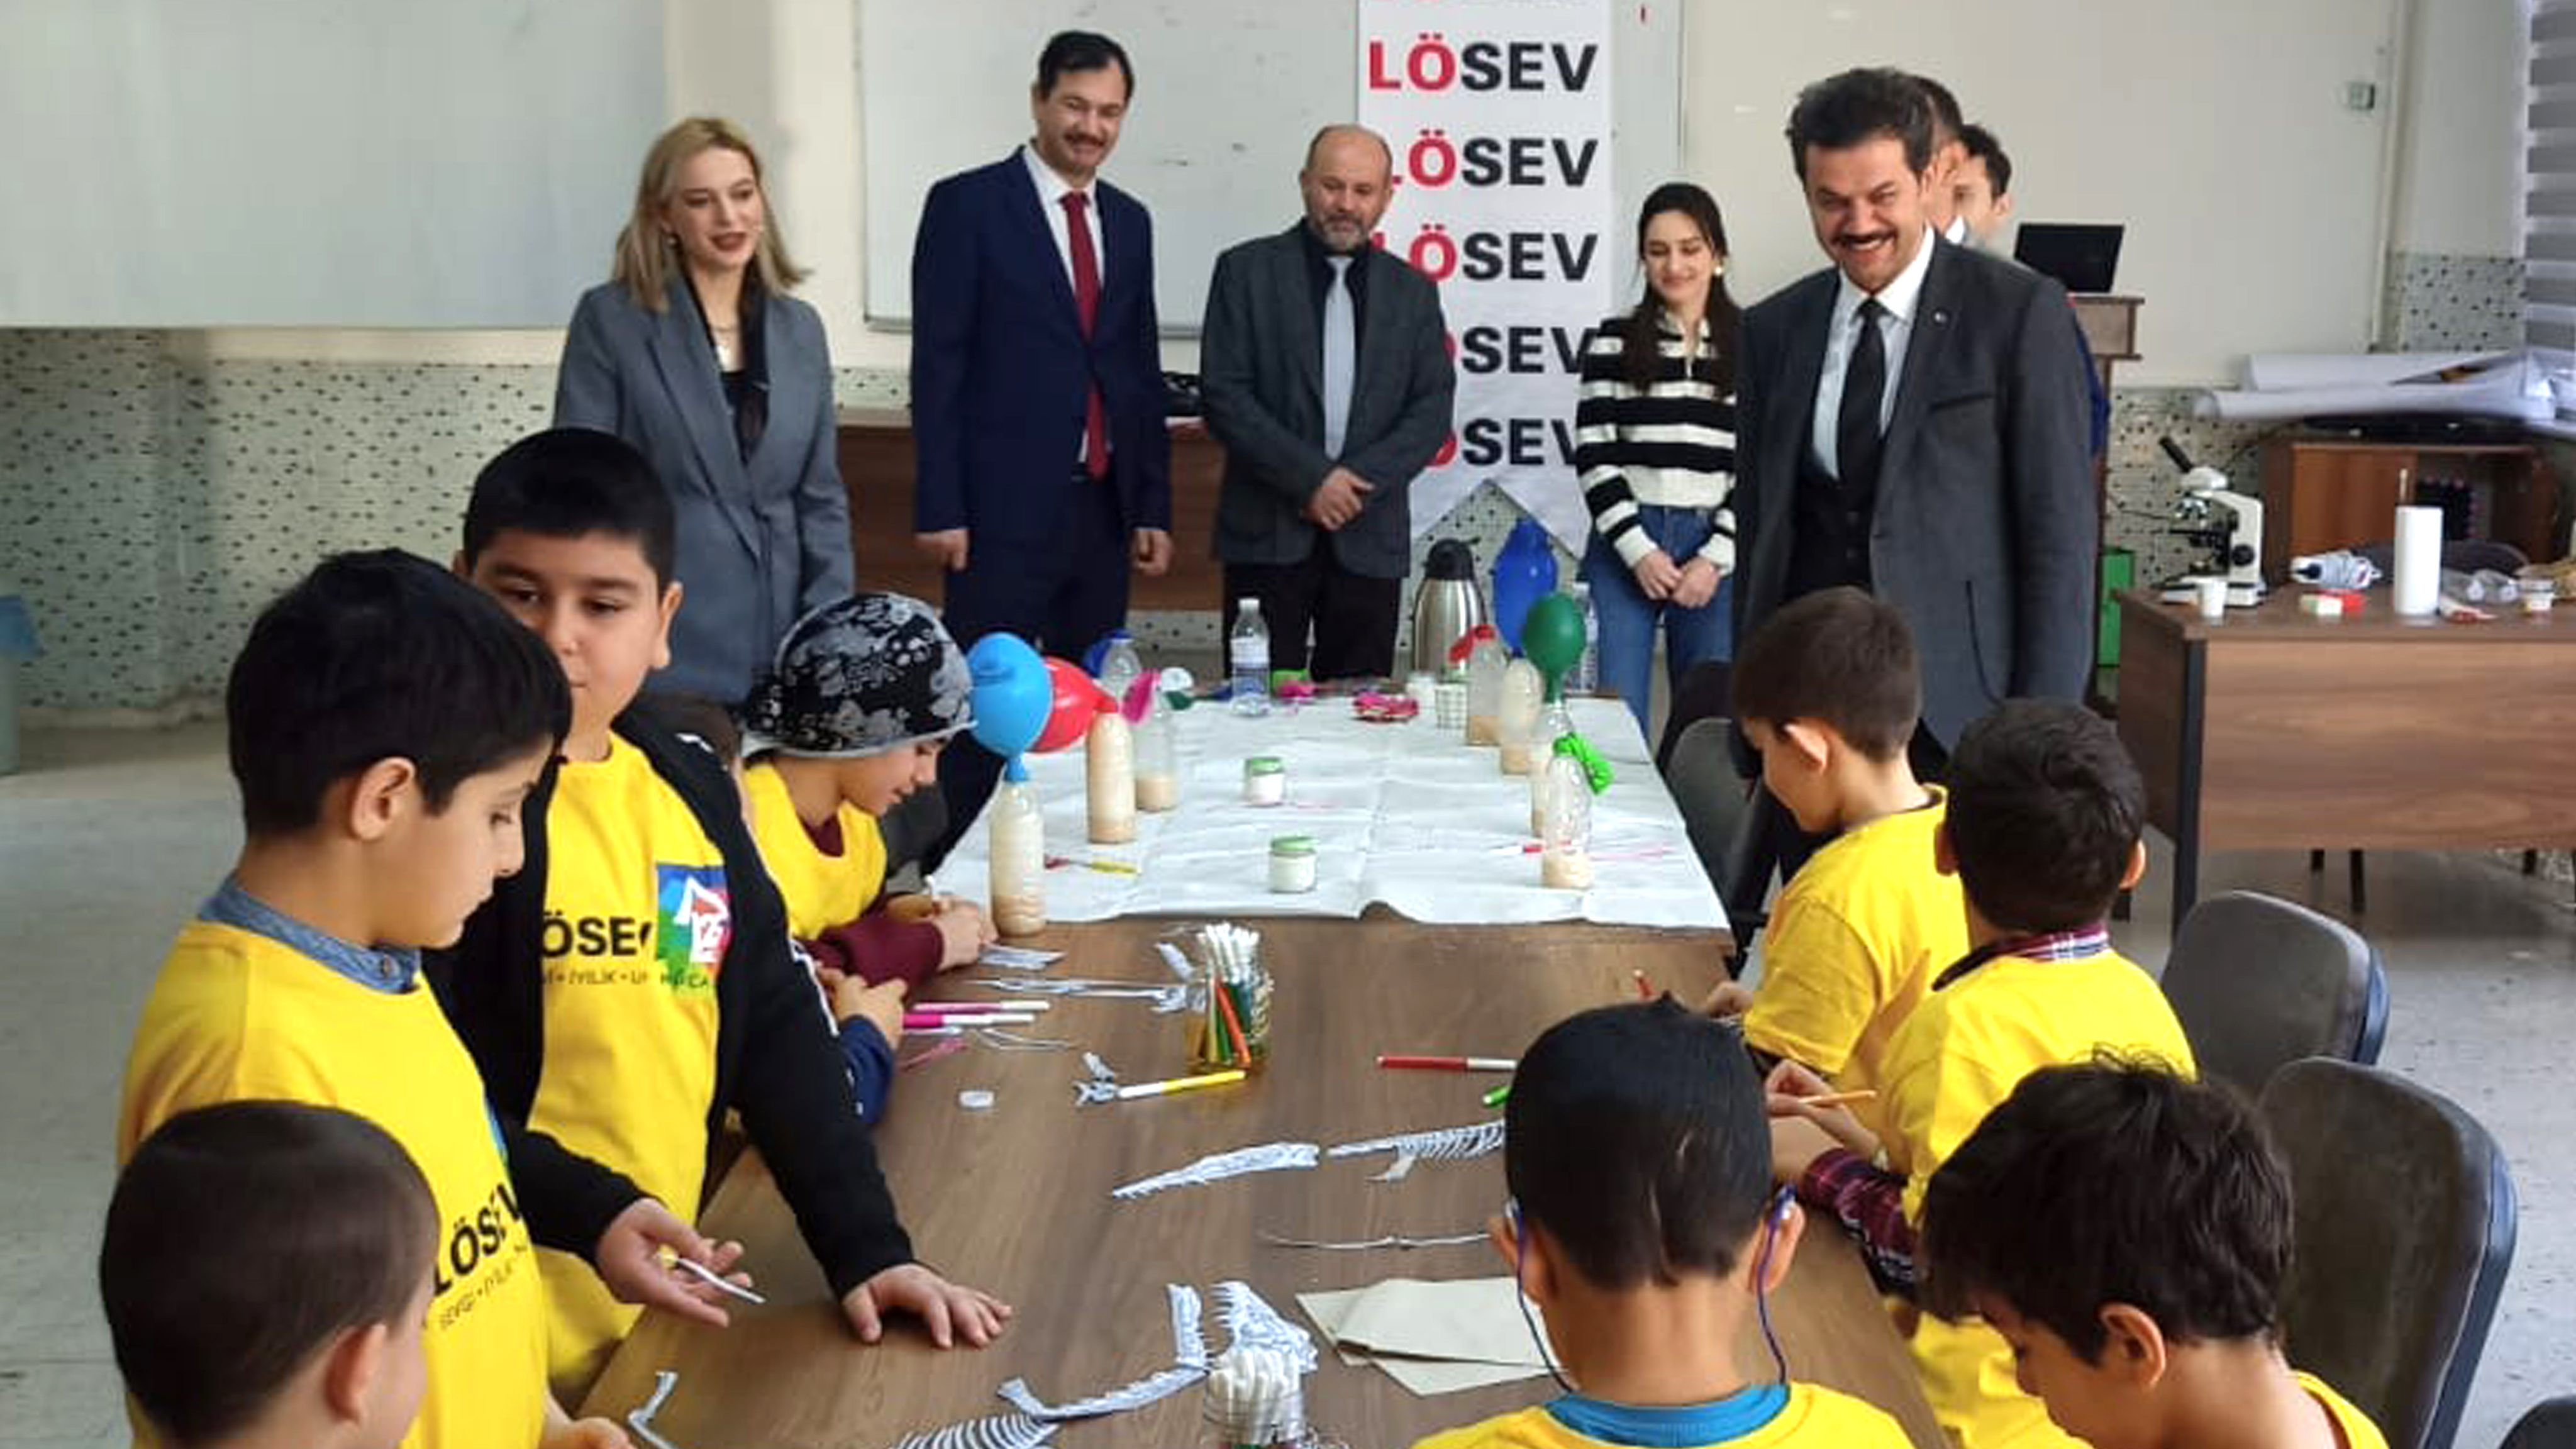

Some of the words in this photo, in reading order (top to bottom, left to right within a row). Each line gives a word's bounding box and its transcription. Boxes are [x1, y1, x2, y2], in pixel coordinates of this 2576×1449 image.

[1368, 33, 1598, 91] LÖSEV
[1392, 129, 1598, 187] ÖSEV
[1371, 224, 1598, 282] ÖSEV
[1445, 326, 1599, 374] SEV
